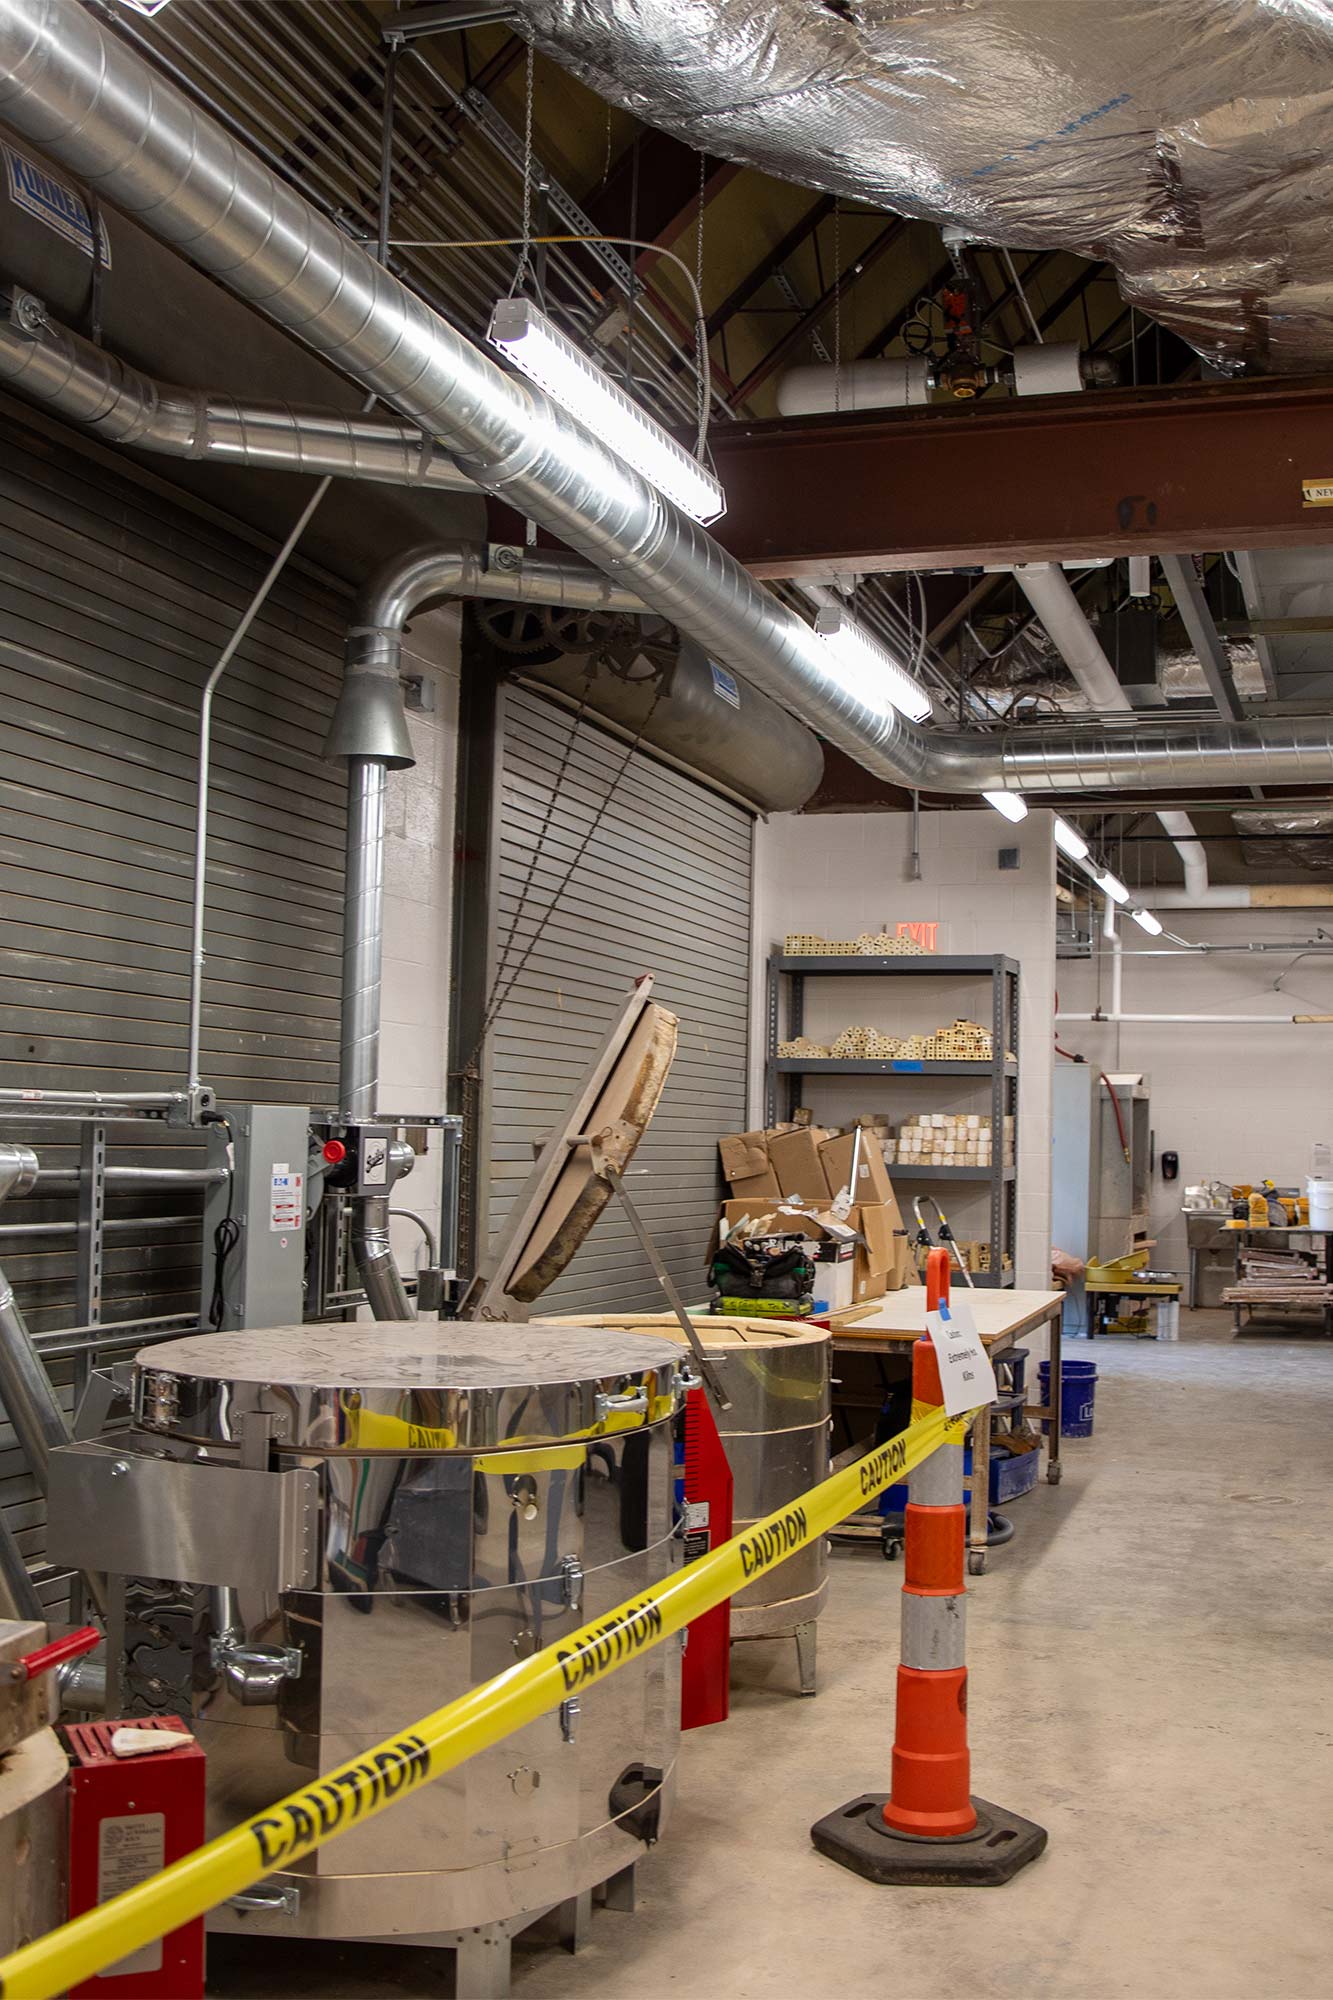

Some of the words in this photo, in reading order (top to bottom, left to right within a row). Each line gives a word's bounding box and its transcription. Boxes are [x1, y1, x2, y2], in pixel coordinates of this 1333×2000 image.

[859, 1437, 906, 1496] CAUTION
[739, 1506, 808, 1578] CAUTION
[555, 1597, 663, 1692] CAUTION
[251, 1734, 432, 1868] CAUTION
